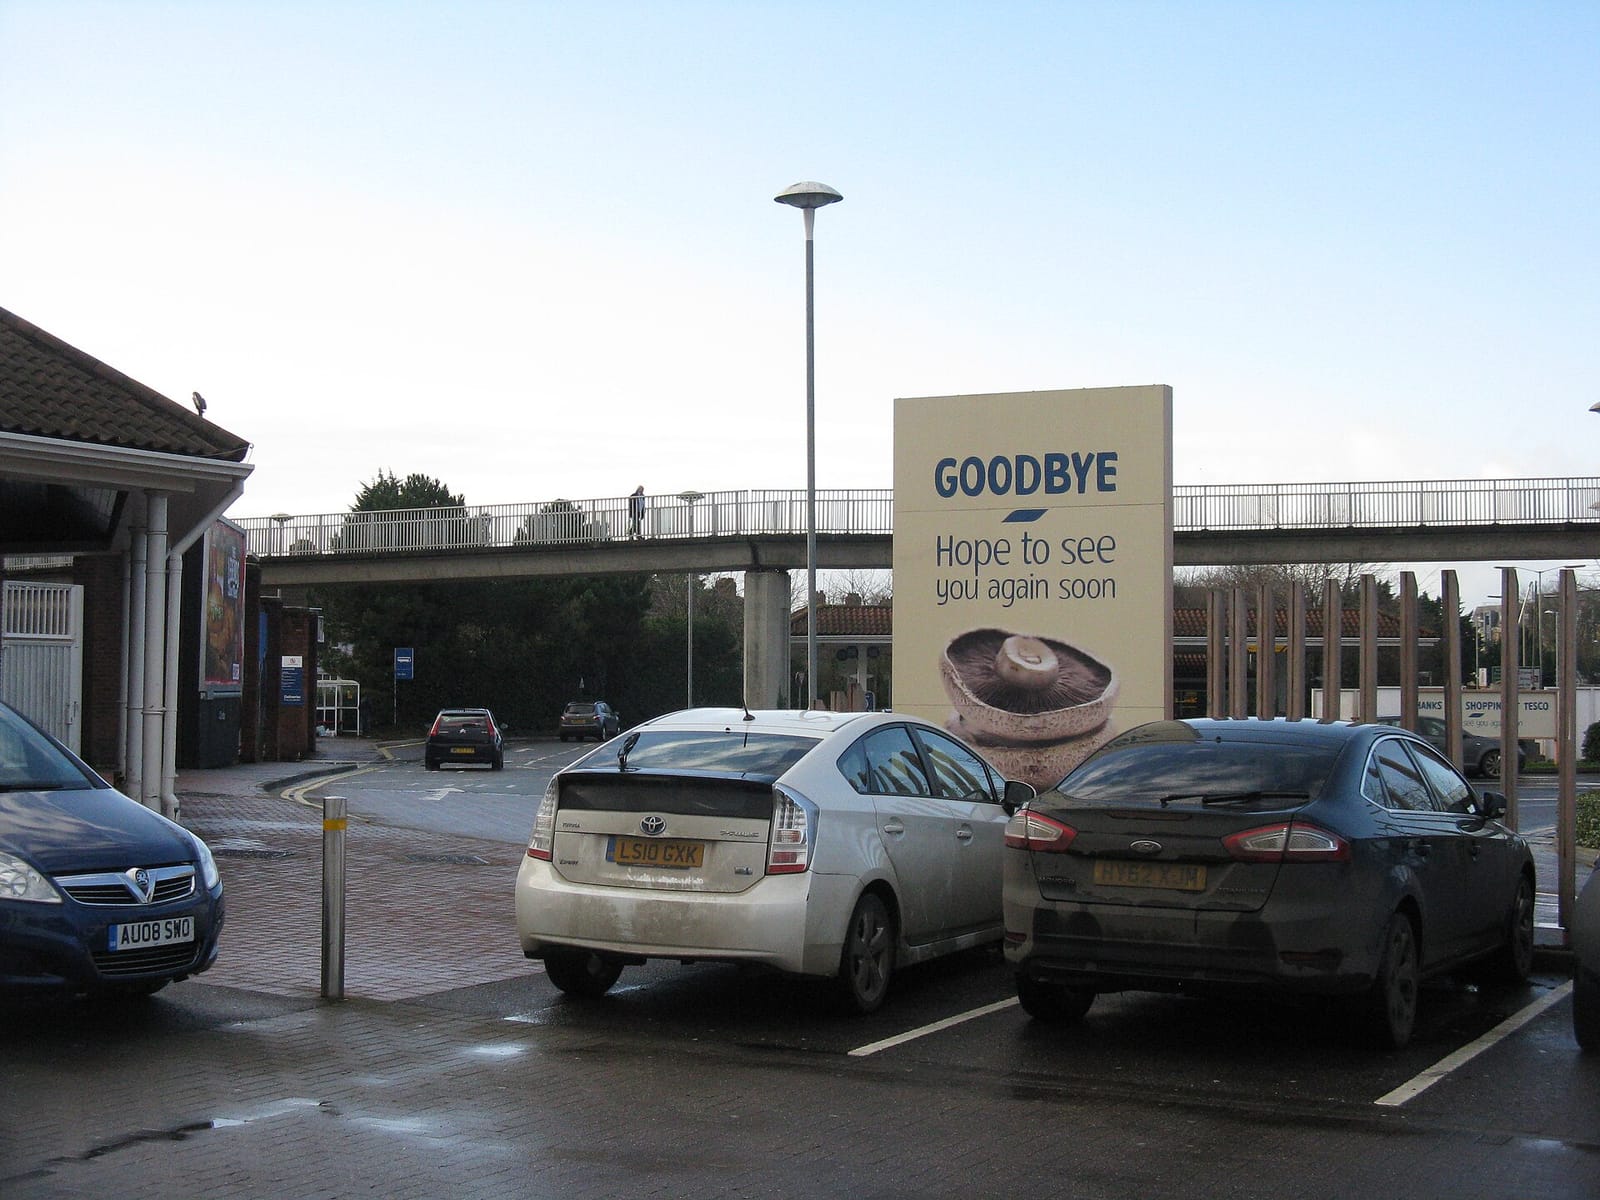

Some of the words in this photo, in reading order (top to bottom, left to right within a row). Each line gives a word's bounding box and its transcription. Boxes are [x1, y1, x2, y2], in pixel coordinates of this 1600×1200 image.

[935, 452, 1118, 498] GOODBYE
[936, 535, 1011, 576] Hope
[1021, 531, 1050, 565] to
[1061, 535, 1116, 565] see
[936, 578, 978, 606] you
[988, 573, 1049, 607] again
[1059, 577, 1116, 600] soon
[1418, 701, 1442, 710] HANKS
[1465, 701, 1502, 711] SHOPPIN
[1524, 701, 1549, 711] TESCO
[619, 843, 657, 862] LS10
[663, 846, 697, 864] GXK
[121, 922, 160, 945] AU08
